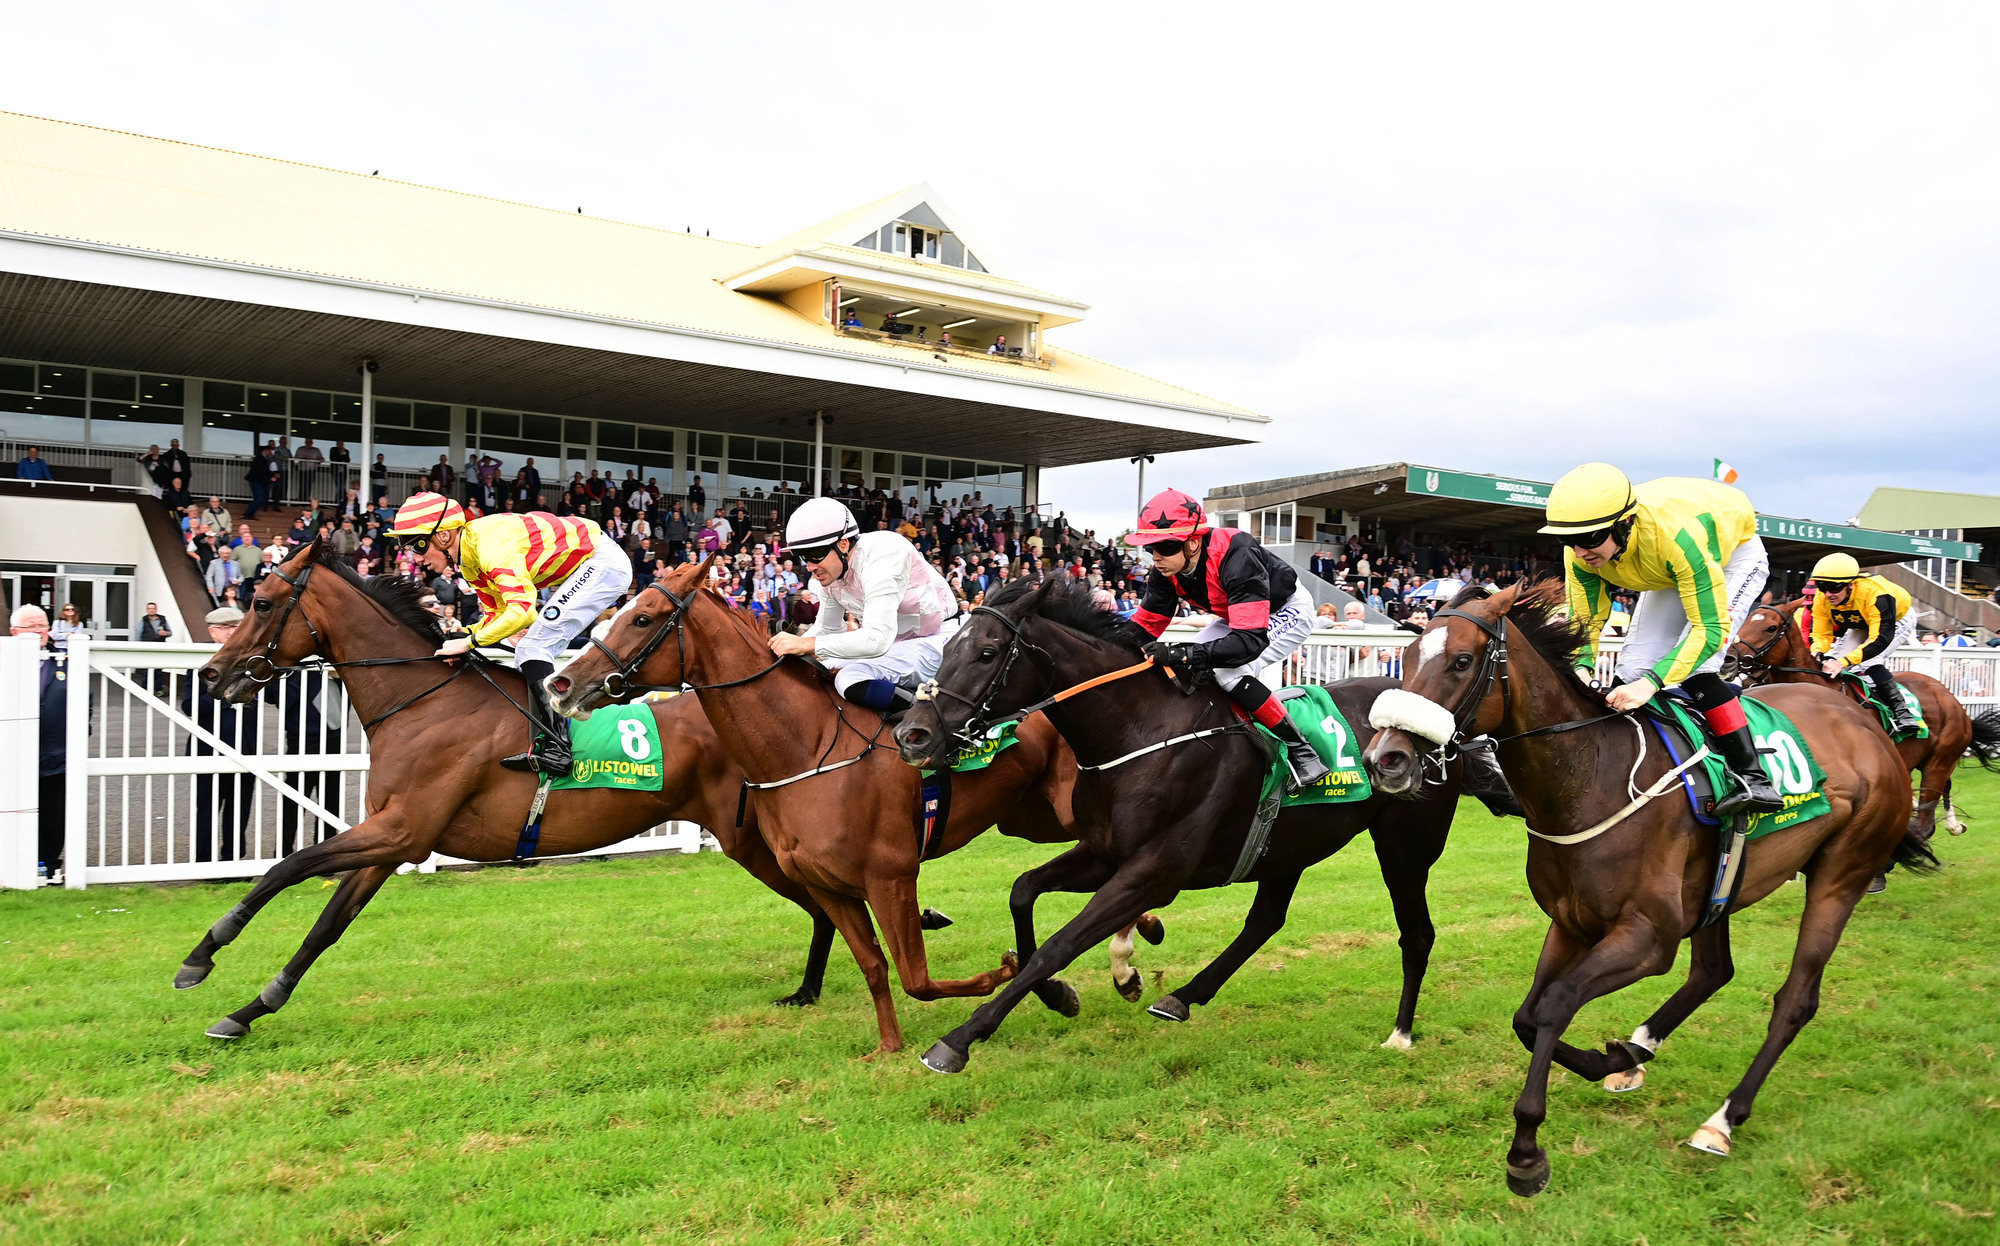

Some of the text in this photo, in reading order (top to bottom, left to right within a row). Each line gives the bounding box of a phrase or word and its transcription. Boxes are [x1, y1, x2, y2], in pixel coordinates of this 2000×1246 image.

[1778, 522, 1823, 539] RACES
[557, 566, 595, 605] Morrison
[617, 718, 651, 760] 8
[1320, 715, 1356, 768] 2
[593, 760, 659, 777] LISTOWEL
[614, 776, 637, 785] races
[1325, 787, 1346, 796] races
